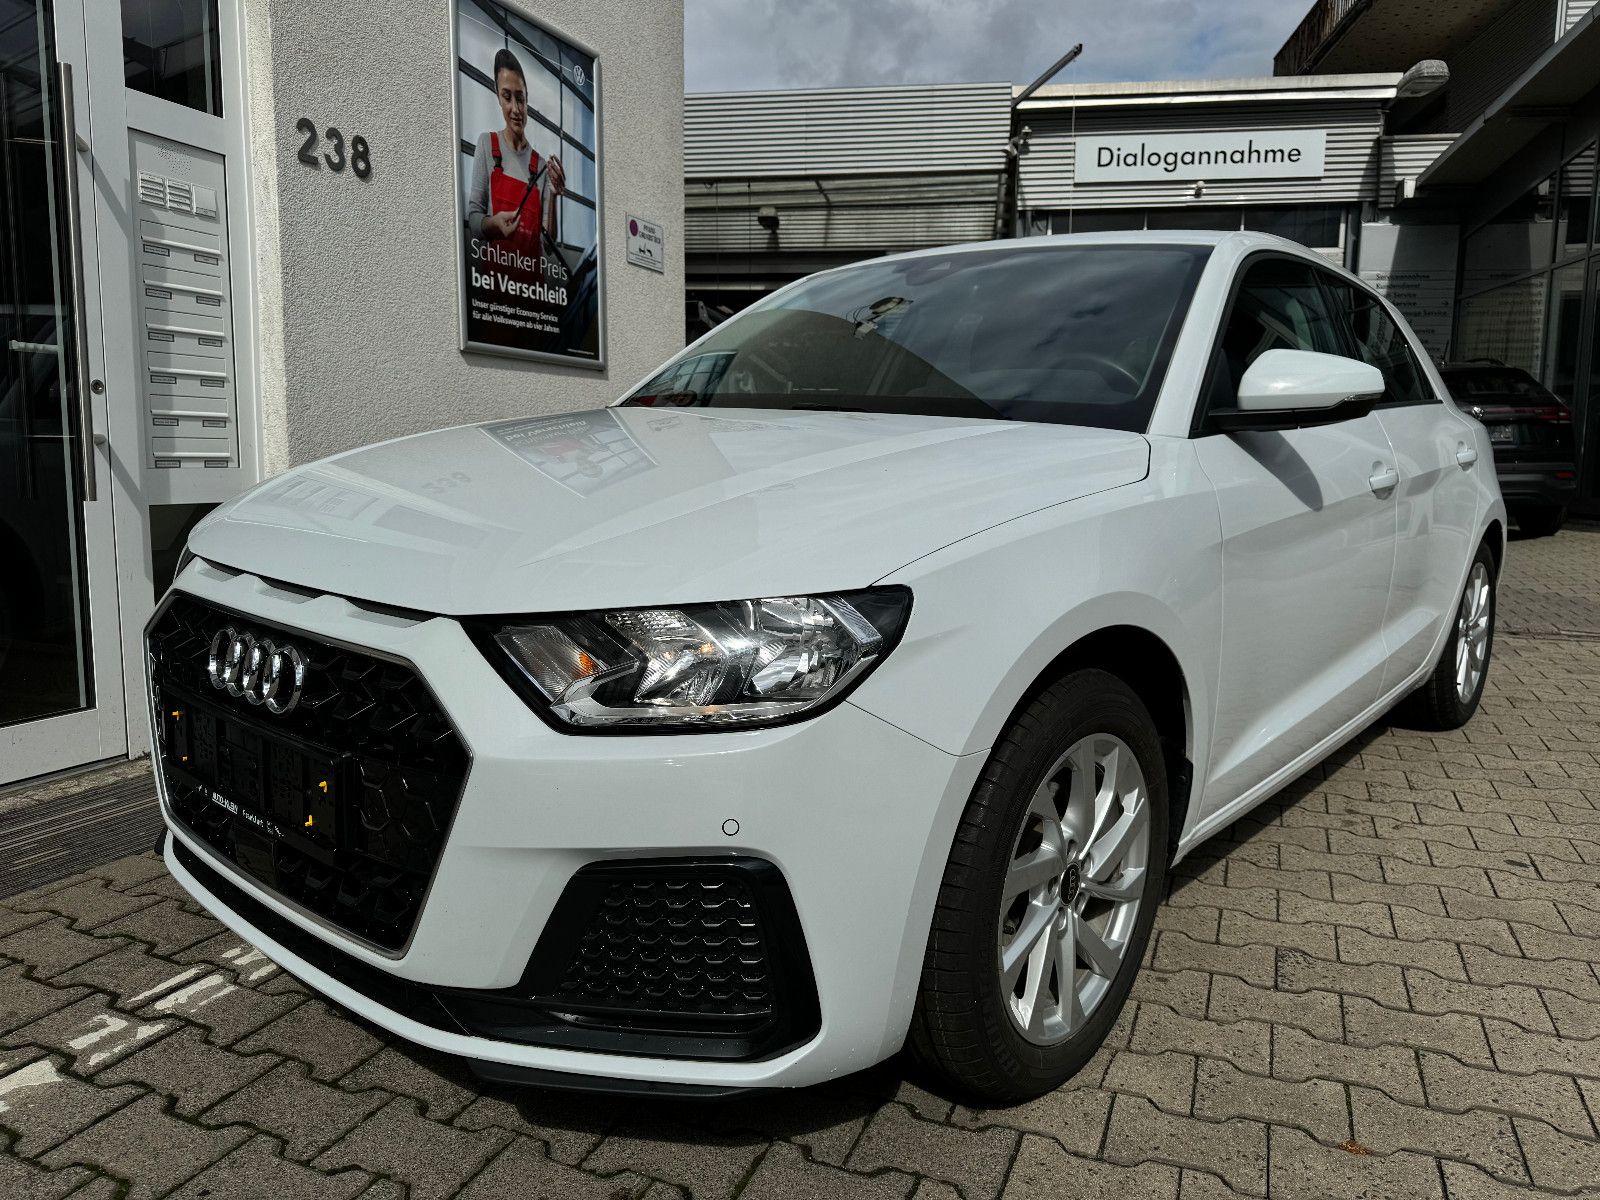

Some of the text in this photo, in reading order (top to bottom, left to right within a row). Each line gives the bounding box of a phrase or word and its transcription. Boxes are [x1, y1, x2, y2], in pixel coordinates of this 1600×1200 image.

[296, 117, 372, 179] 238
[1097, 139, 1302, 173] Dialogannahme
[471, 238, 568, 281] Schlanker Preis
[471, 266, 568, 306] bei Verschleiß
[472, 298, 559, 323] Unser günstiger Economy Service
[472, 310, 560, 333] für alle Volkswagen ab vier Jahren
